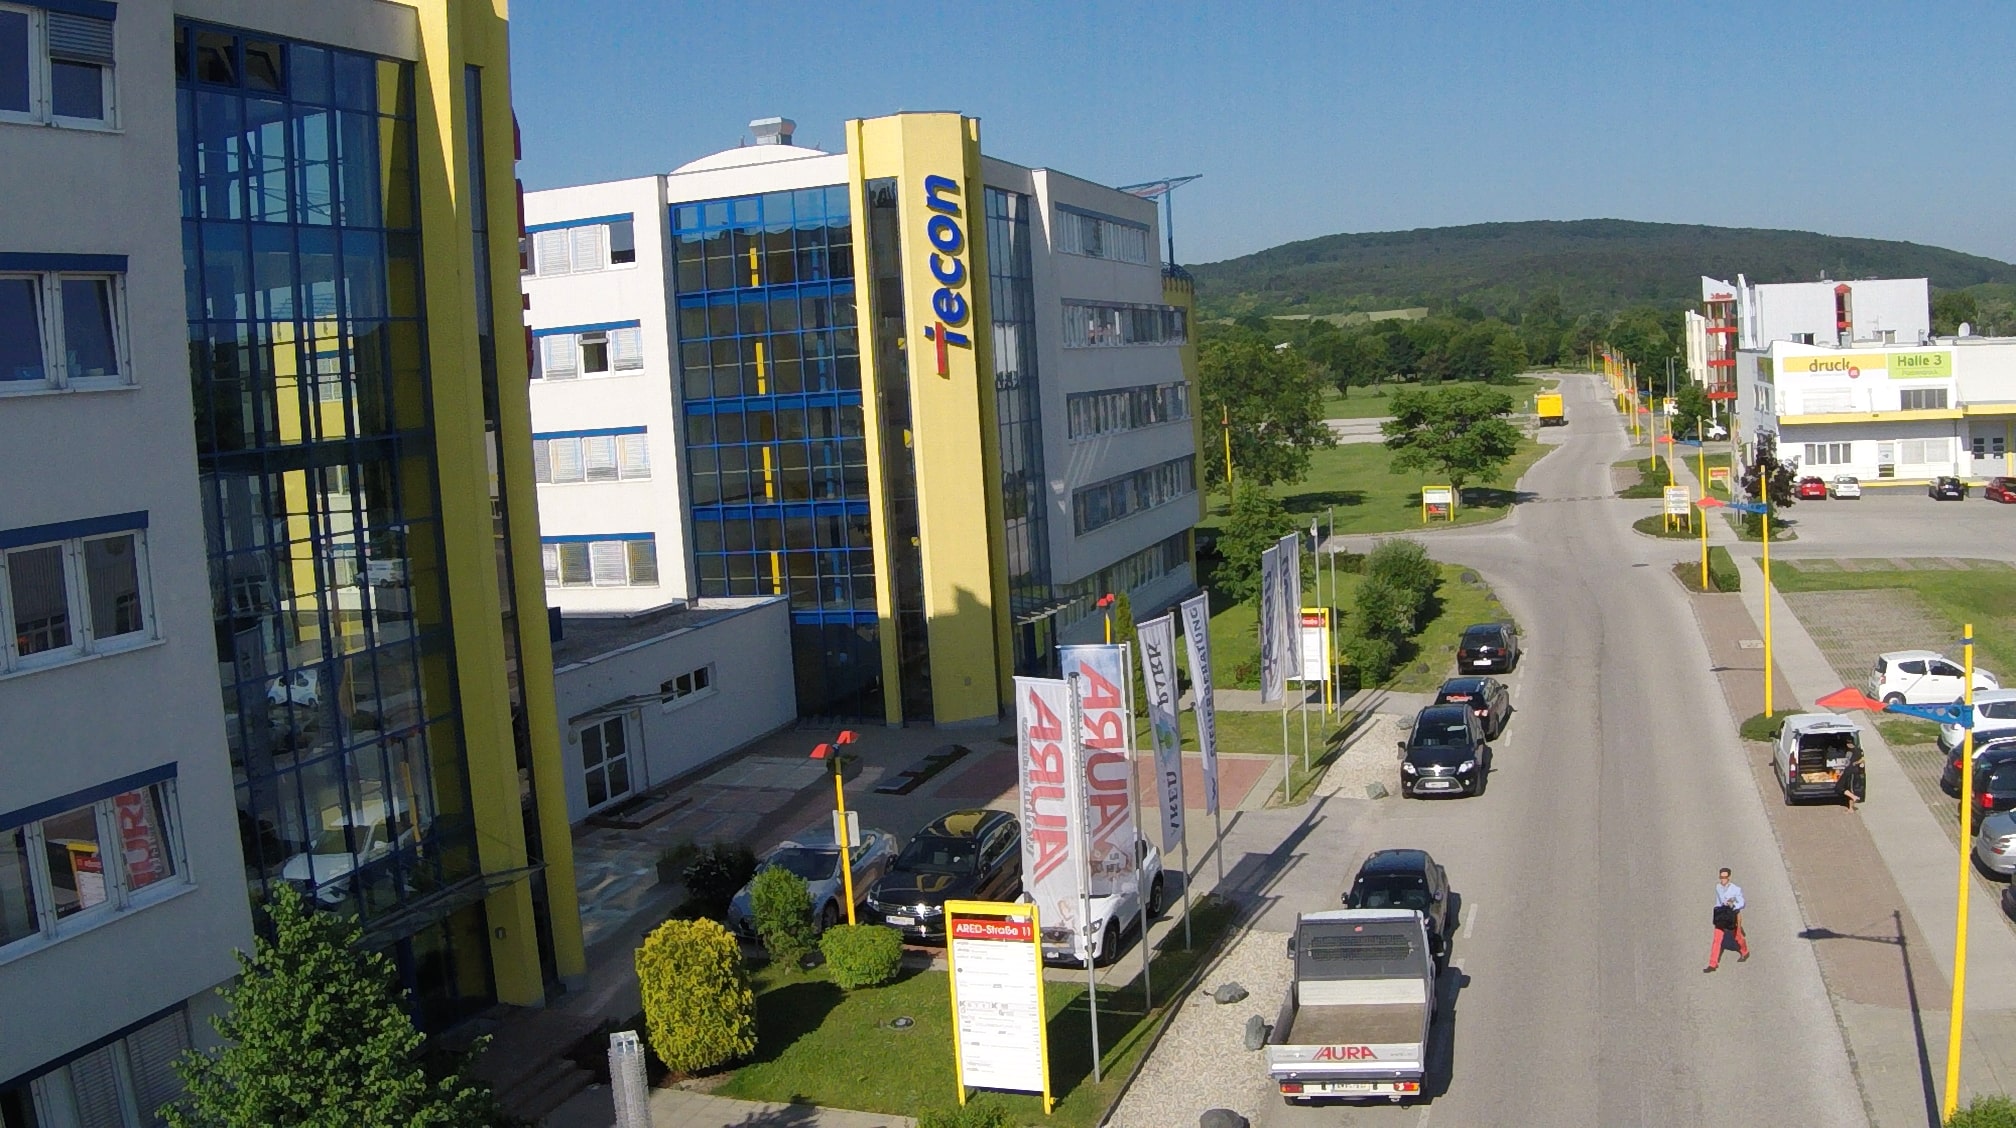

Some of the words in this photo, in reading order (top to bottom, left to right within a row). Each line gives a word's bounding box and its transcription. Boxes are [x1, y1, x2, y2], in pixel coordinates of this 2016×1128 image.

[1809, 357, 1850, 372] druck
[1897, 355, 1930, 367] Halle
[1933, 355, 1943, 366] 3
[1312, 1046, 1379, 1060] AURA
